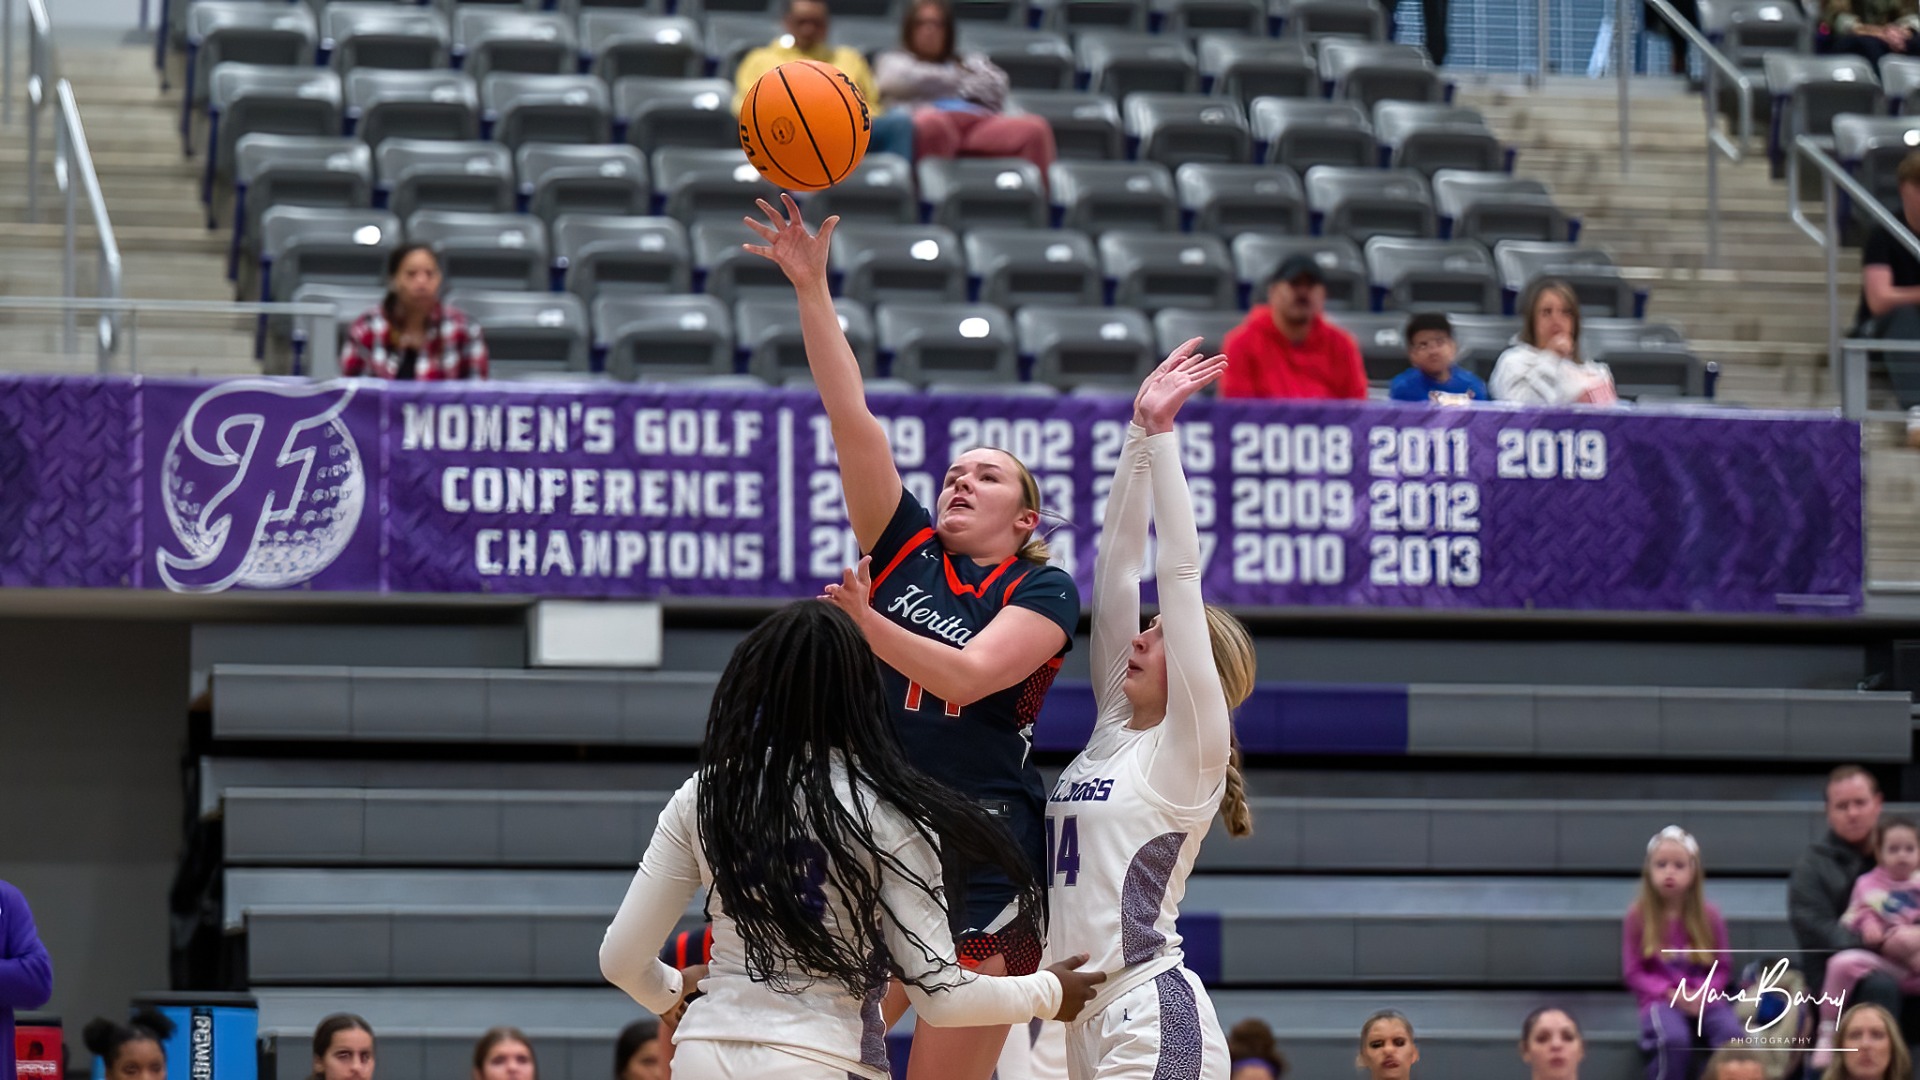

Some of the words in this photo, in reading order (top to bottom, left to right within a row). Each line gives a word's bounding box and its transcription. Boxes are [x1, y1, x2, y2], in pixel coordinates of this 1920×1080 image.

[401, 403, 615, 453] WOMEN'S
[634, 408, 763, 457] GOLF
[808, 415, 925, 467] 19
[1092, 420, 1215, 472] 25
[1231, 423, 1353, 475] 2008
[1368, 426, 1469, 477] 2011
[1497, 428, 1607, 480] 2019
[441, 466, 764, 518] CONFERENCE
[1232, 478, 1354, 530] 2009
[1368, 480, 1481, 532] 2012
[475, 529, 764, 580] CHAMPIONS
[1232, 533, 1345, 584] 2010
[1369, 535, 1481, 587] 2013
[887, 584, 972, 646] Herita
